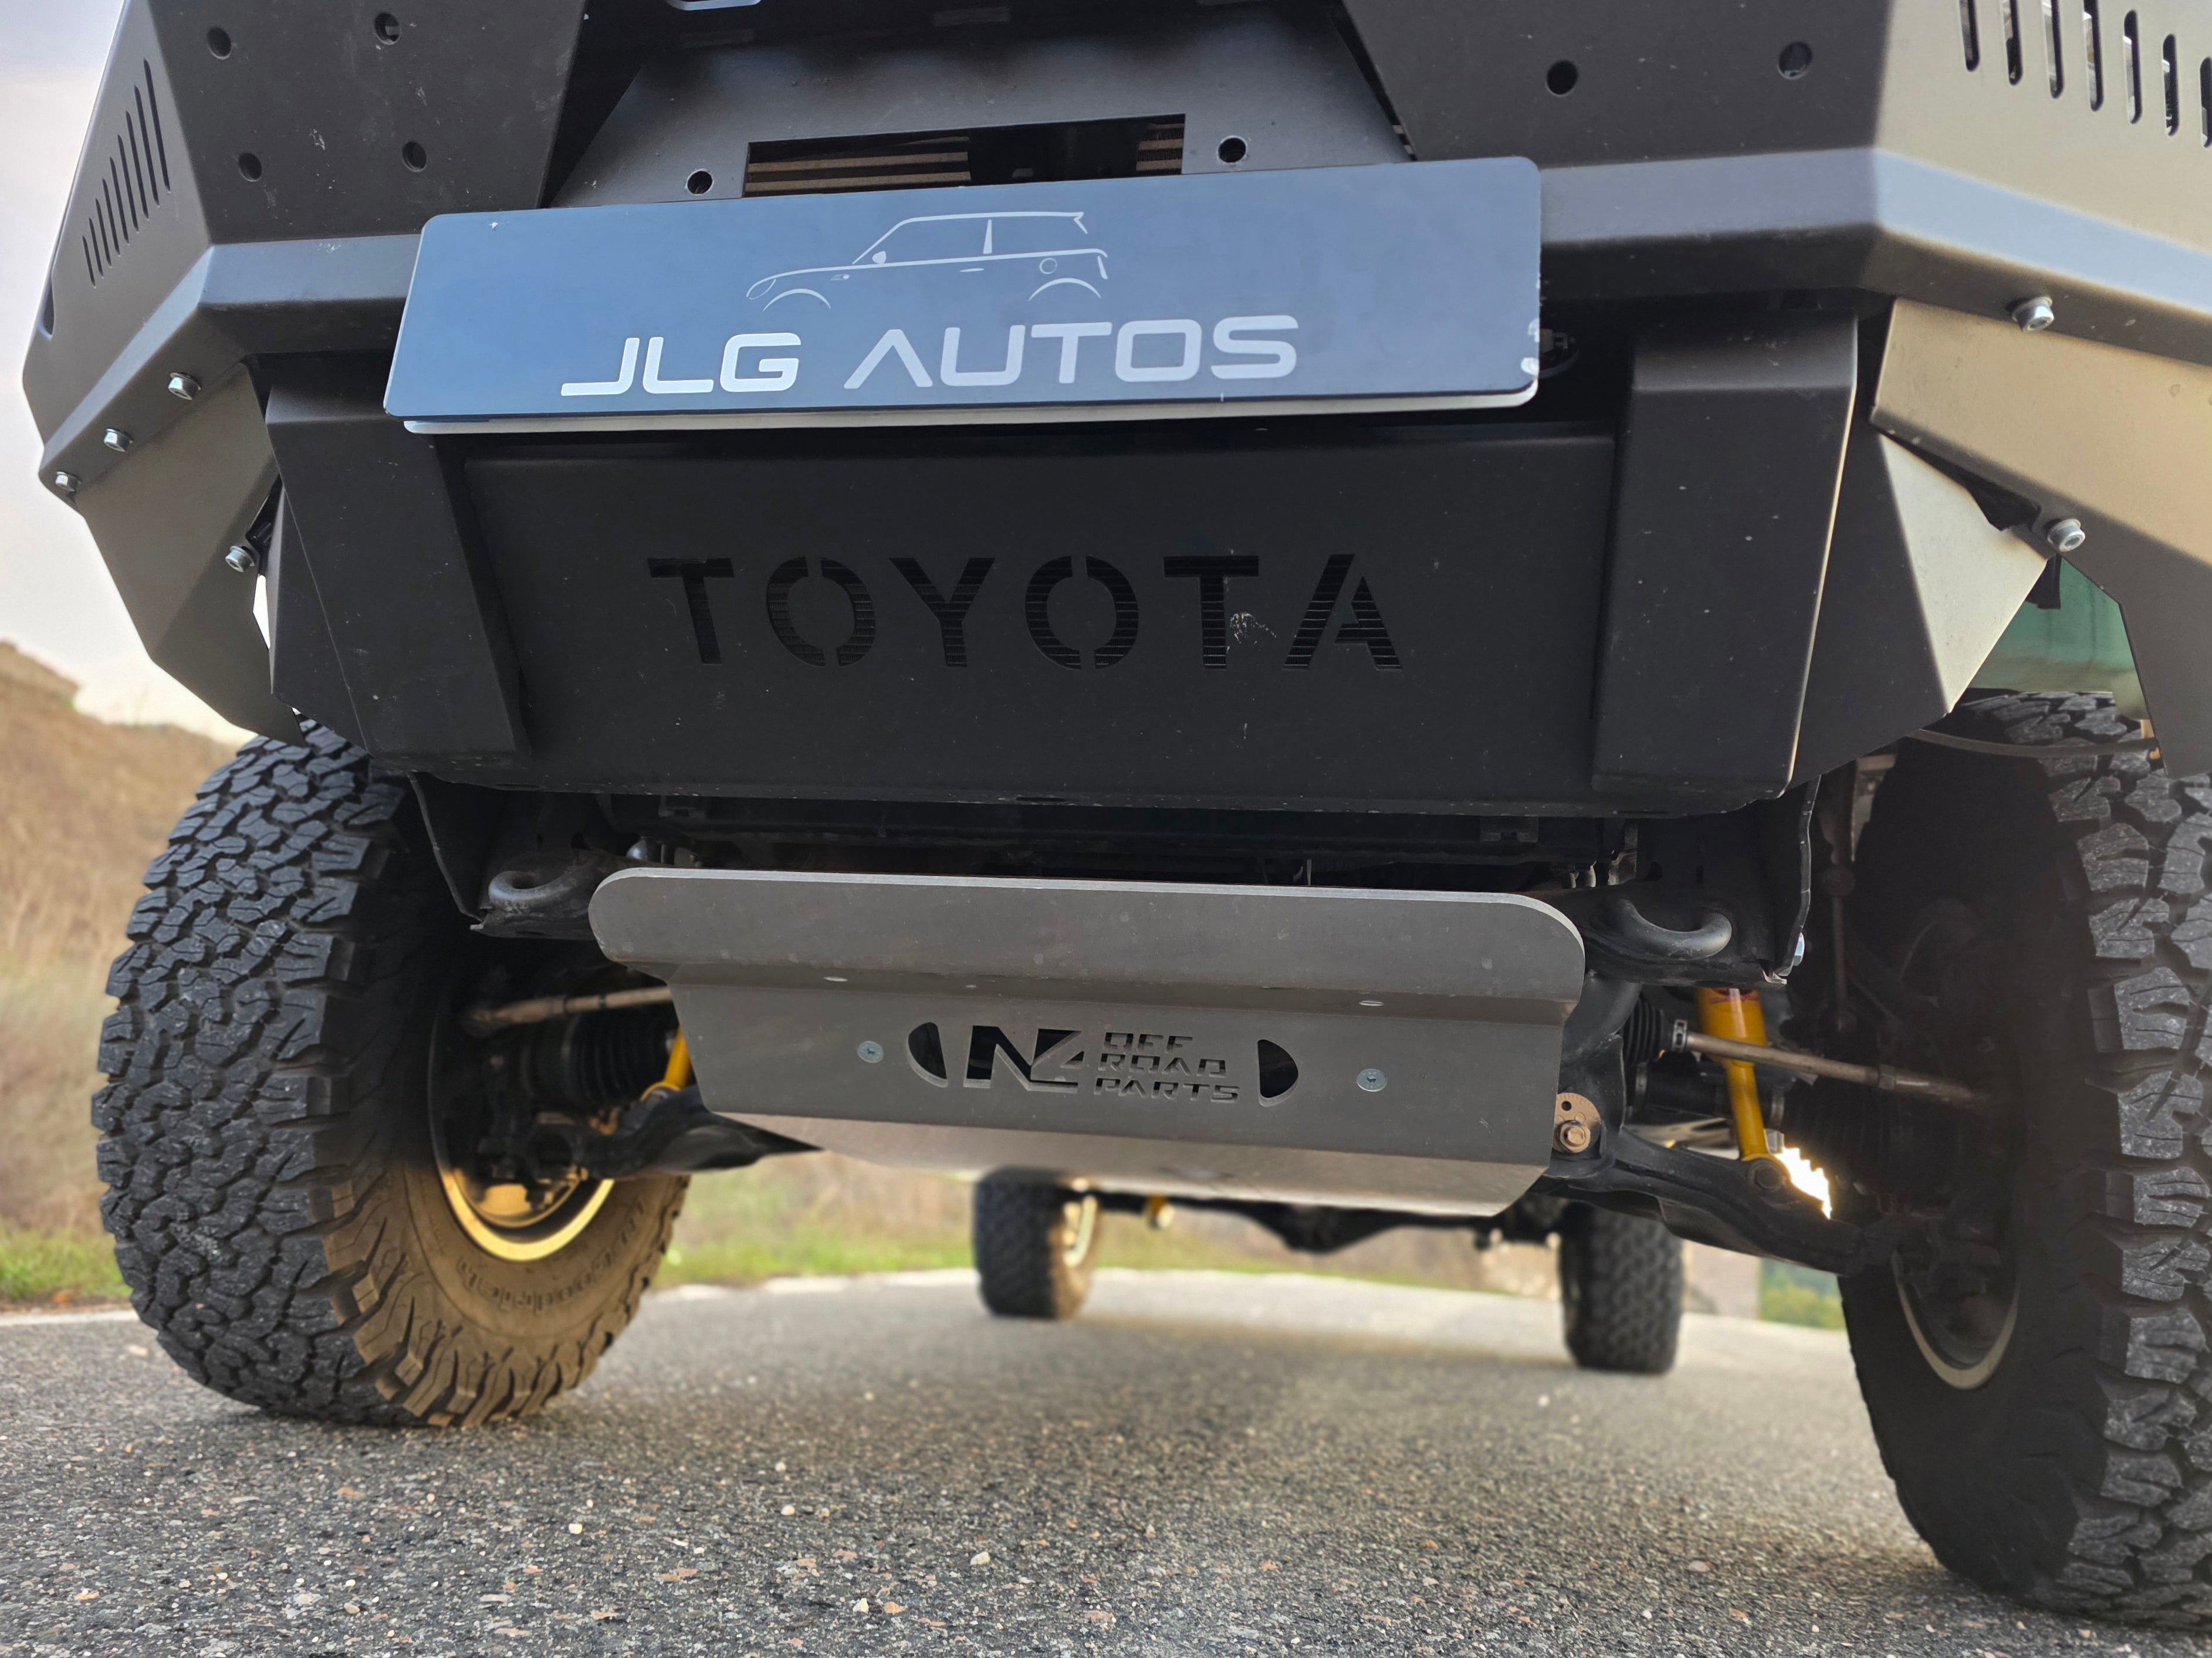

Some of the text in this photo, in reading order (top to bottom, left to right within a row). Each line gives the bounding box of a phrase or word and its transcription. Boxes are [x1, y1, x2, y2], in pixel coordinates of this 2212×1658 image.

[561, 314, 1299, 397] JLG AUTOS
[647, 554, 1403, 671] TOYOTA
[1103, 1032, 1193, 1054] OFF
[1098, 1053, 1227, 1078] ROAD
[1093, 1077, 1240, 1104] PARTS
